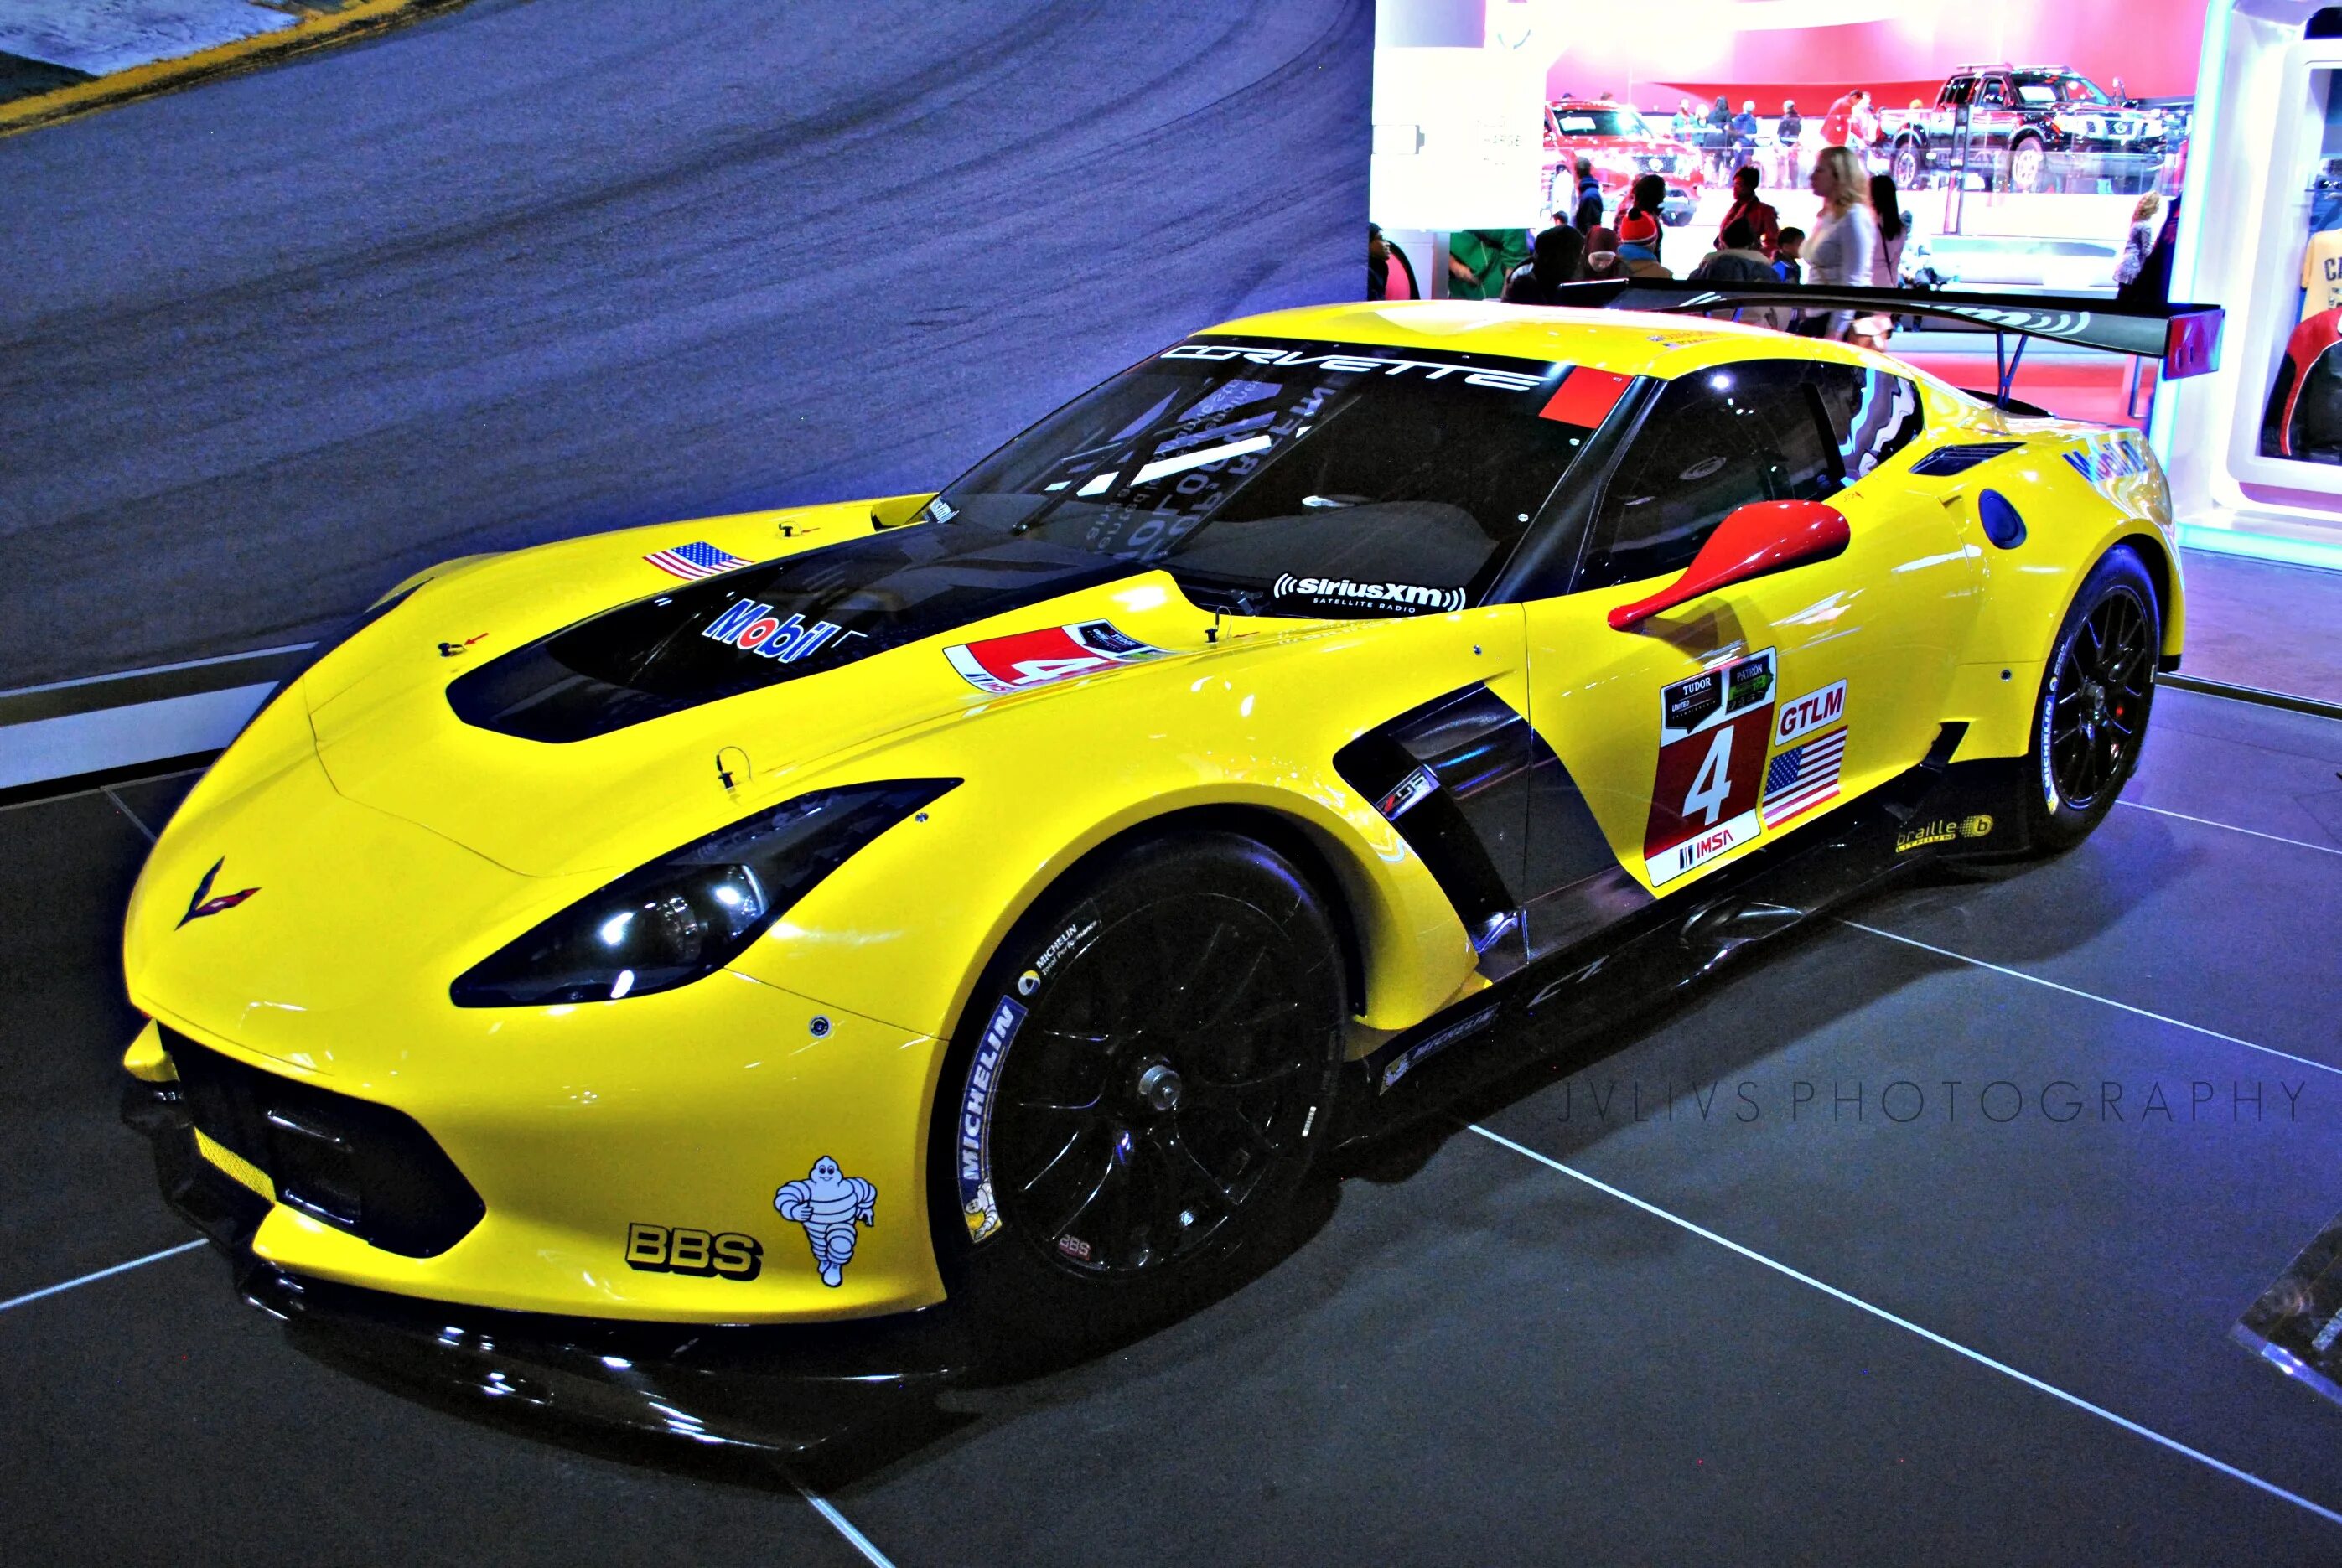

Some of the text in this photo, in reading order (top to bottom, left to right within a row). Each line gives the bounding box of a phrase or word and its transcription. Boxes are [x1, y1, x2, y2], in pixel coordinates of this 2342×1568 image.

[1160, 344, 1551, 391] CORVETTE
[1313, 598, 1416, 613] SATELLITE RADIO
[701, 598, 842, 664] Mobil
[1011, 656, 1111, 686] 4
[1682, 677, 1712, 696] TUDOR
[1780, 687, 1843, 736] GTLM
[1681, 724, 1734, 825] 4
[1697, 829, 1734, 859] IMSA
[1897, 820, 1956, 846] braille
[1036, 924, 1078, 969] MICHELIN
[1042, 956, 1057, 975] Total
[962, 1004, 1014, 1180] MICHELIN
[625, 1223, 764, 1281] BBS
